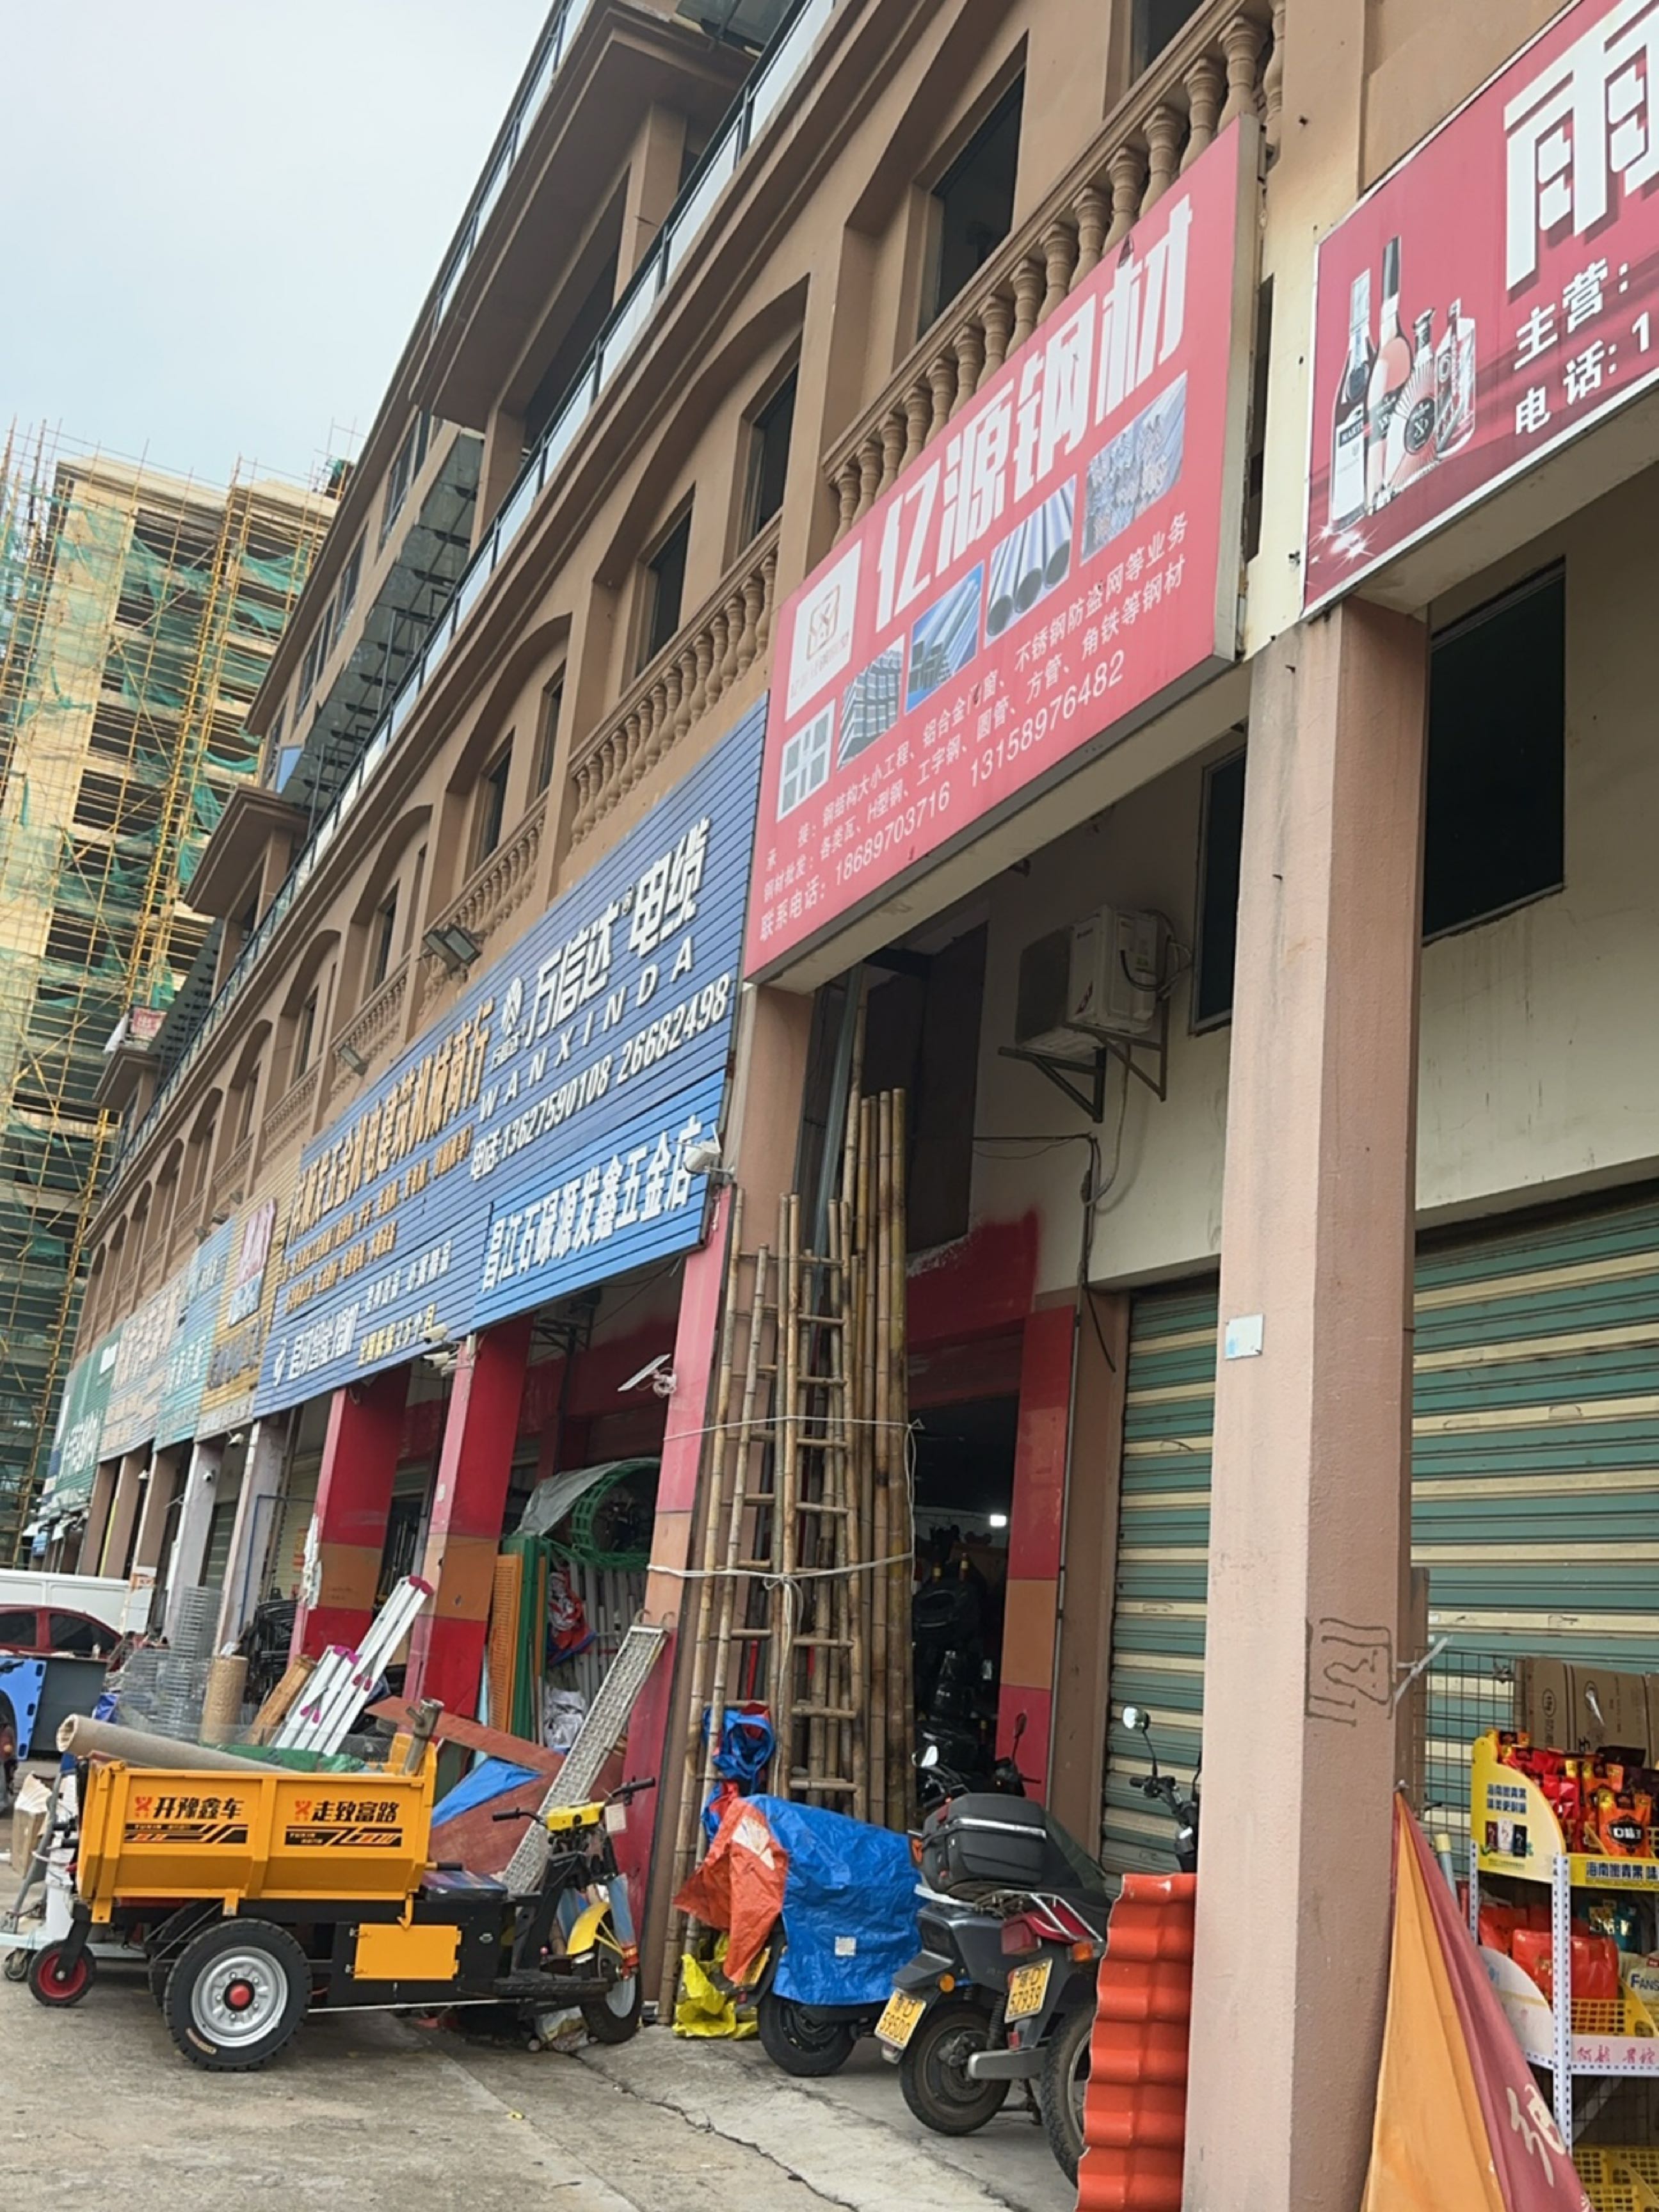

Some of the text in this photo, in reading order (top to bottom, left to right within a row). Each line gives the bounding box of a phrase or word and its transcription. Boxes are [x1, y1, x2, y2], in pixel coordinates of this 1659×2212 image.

[1632, 312, 1649, 353] 1
[875, 193, 1193, 633] 亿源钢材
[835, 780, 950, 886] 18689703716
[971, 650, 1125, 788] 13158976482
[629, 817, 711, 958] 电缆
[617, 973, 733, 1086] 26682498
[312, 1800, 400, 1823] 走致富路
